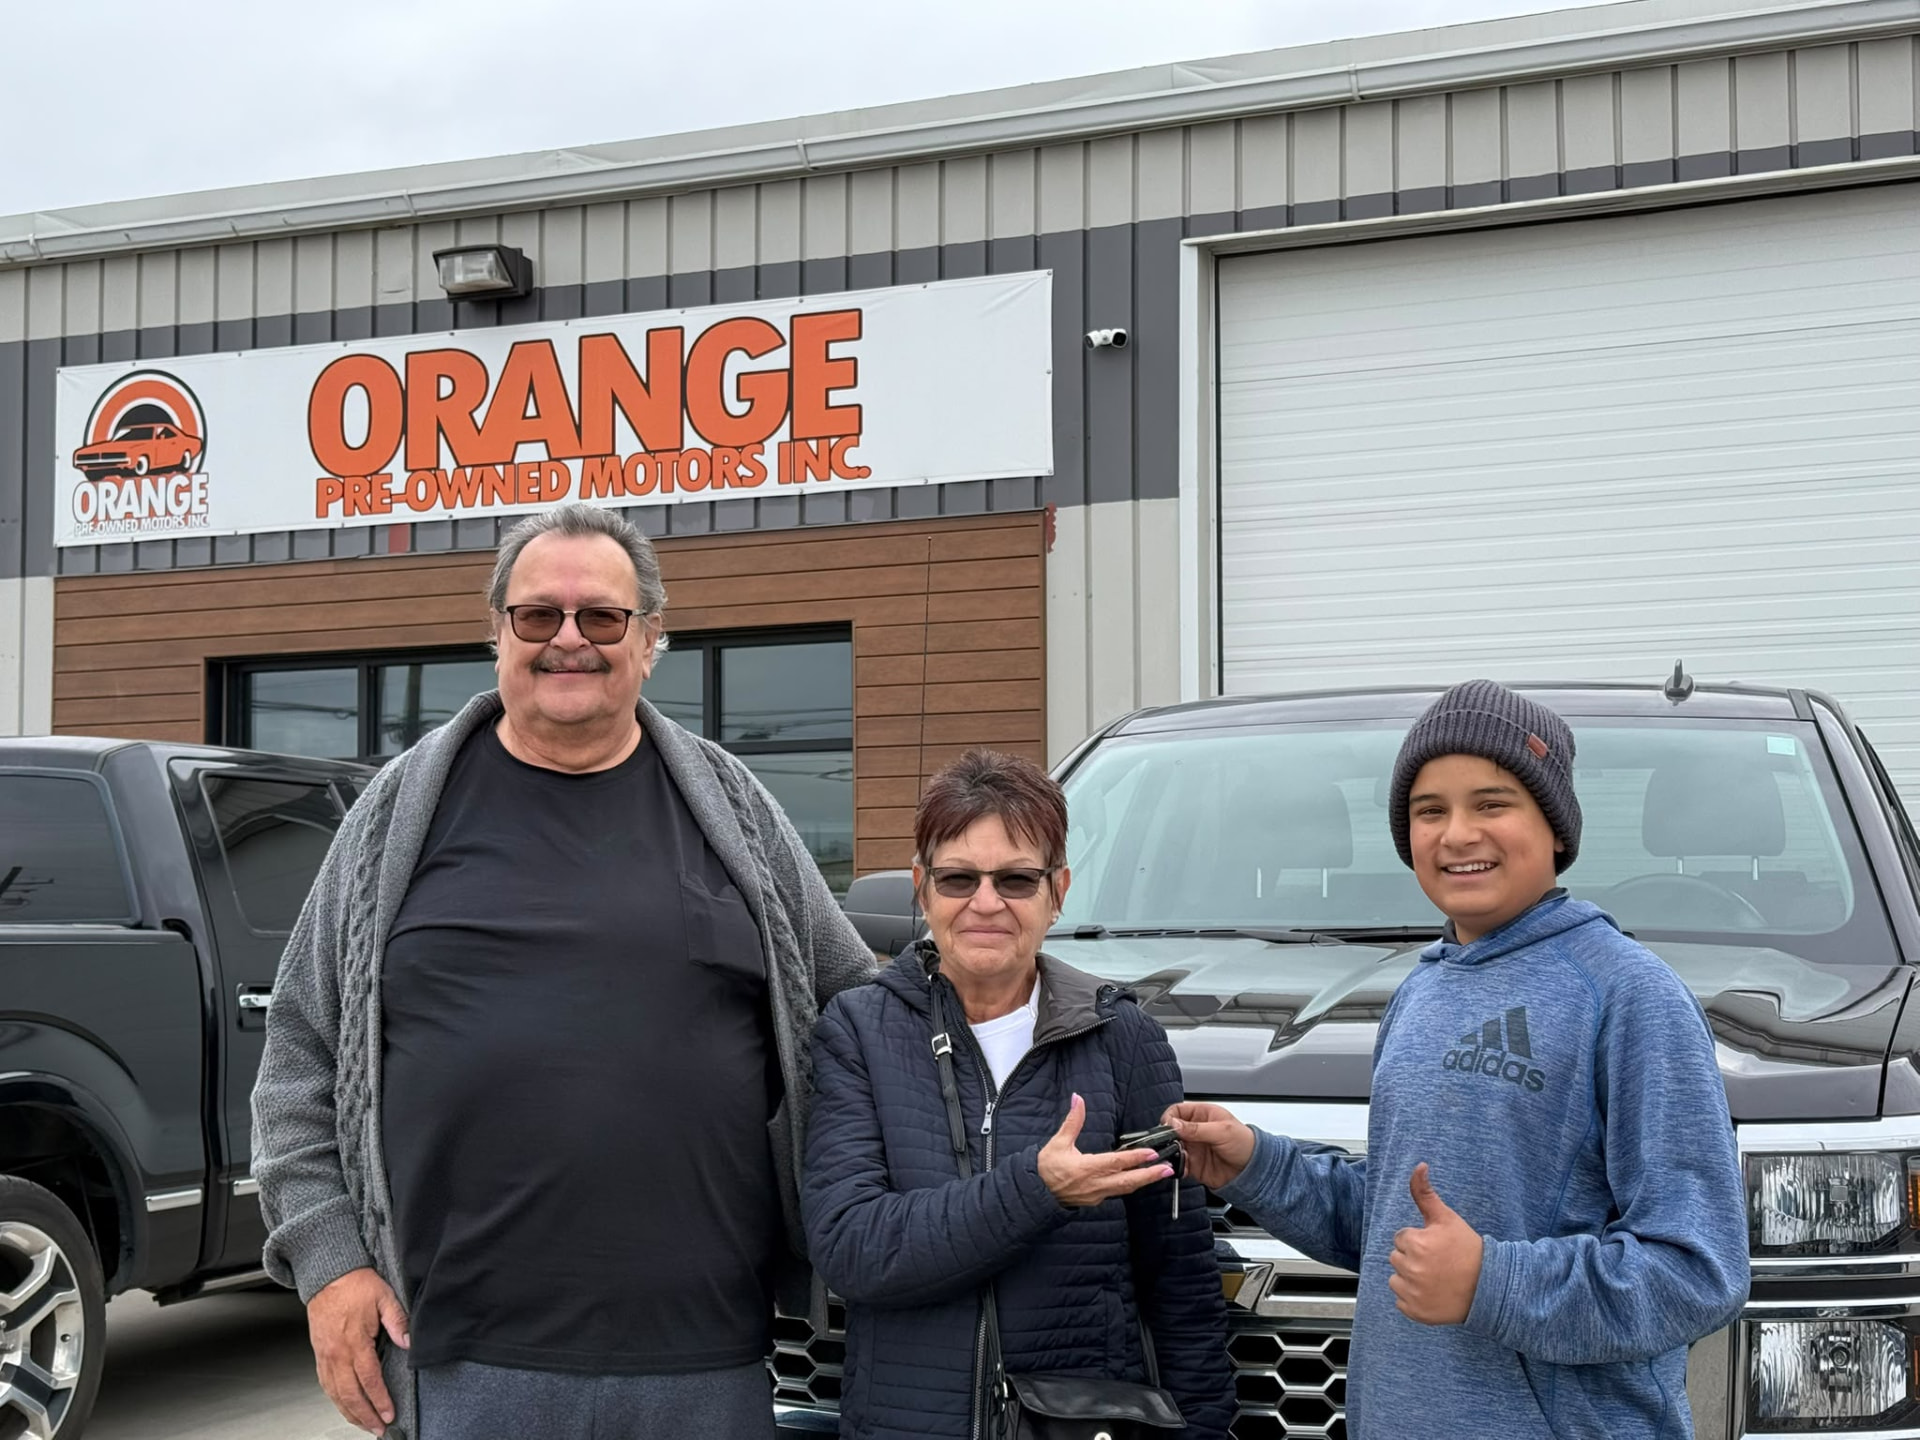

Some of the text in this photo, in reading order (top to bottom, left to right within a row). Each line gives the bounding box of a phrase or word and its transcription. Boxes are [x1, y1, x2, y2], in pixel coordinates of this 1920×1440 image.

[308, 308, 863, 479] ORANGE
[72, 472, 209, 524] ORANGE
[316, 435, 872, 519] PRE-OWNED MOTORS INC.
[74, 518, 139, 537] PRE-OWNED
[141, 515, 185, 532] MOTORS
[1442, 1045, 1546, 1092] adidas
